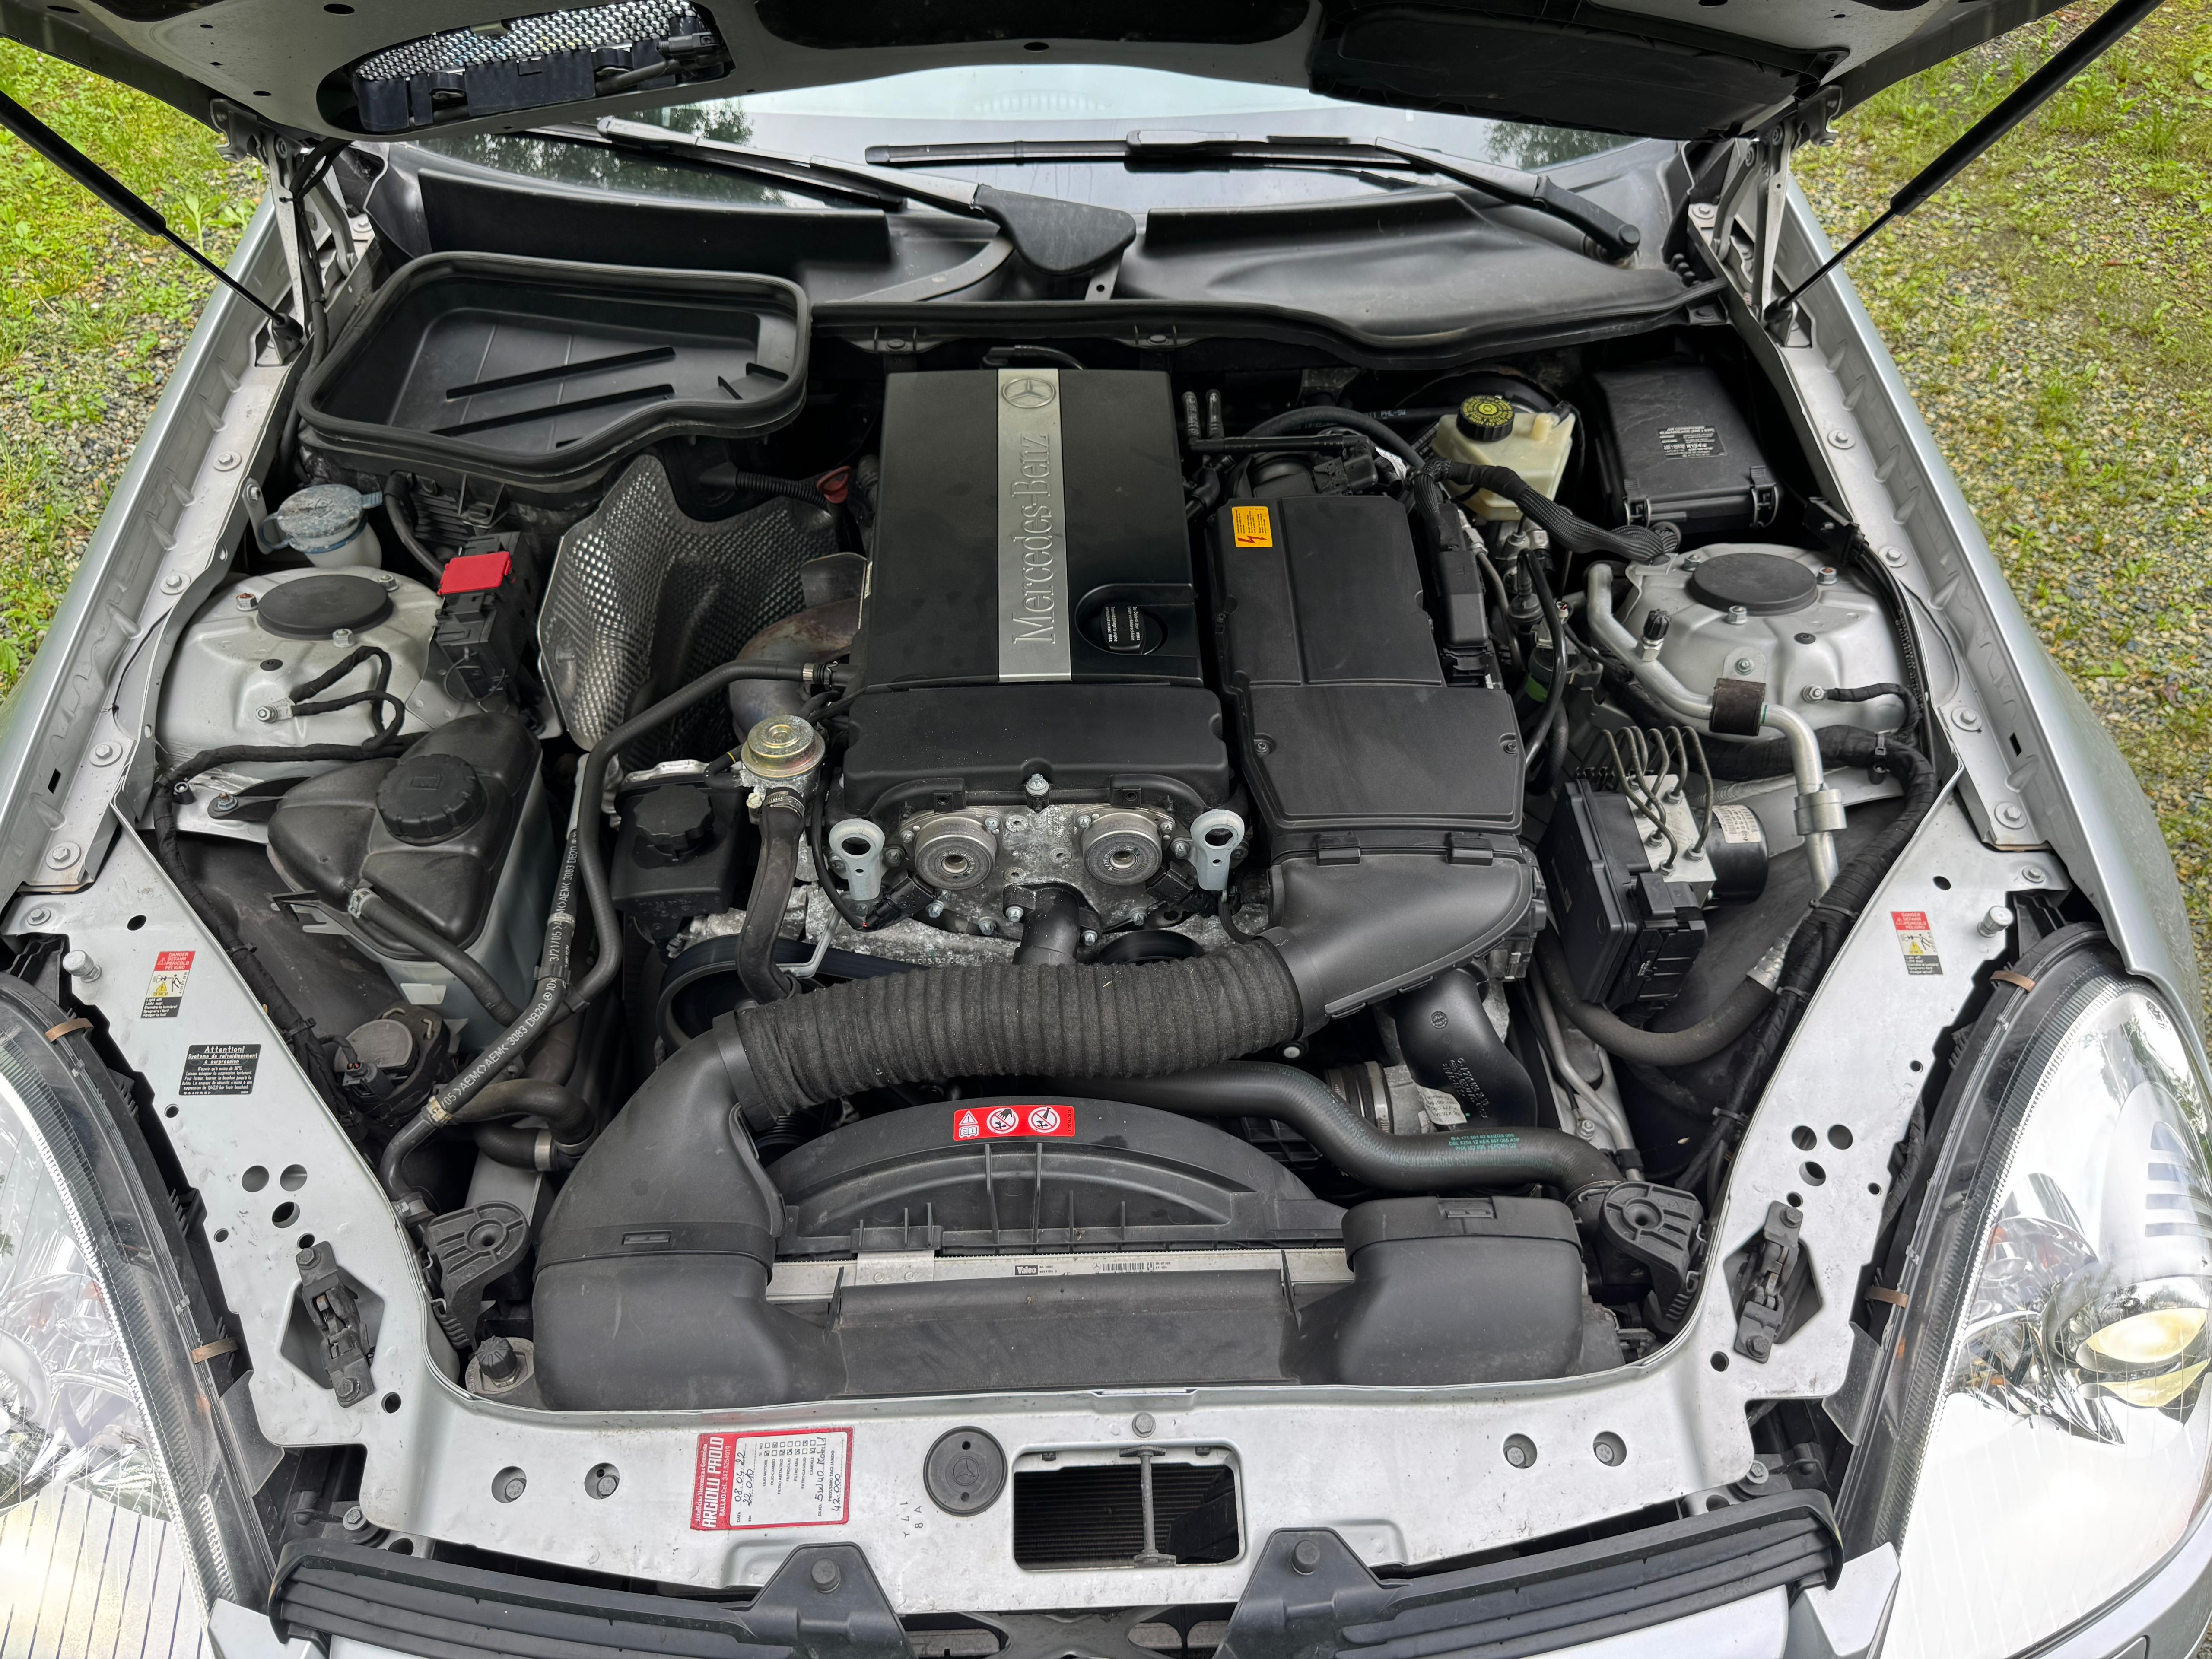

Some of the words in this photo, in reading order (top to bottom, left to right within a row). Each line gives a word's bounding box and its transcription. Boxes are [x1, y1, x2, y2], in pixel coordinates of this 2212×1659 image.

[1011, 433, 1055, 644] Mercedes-Benz
[563, 862, 575, 881] 3083
[506, 1025, 528, 1046] 3083
[524, 1002, 548, 1028] DB20
[1017, 1266, 1036, 1274] Valeo
[707, 1437, 724, 1474] PAOLO
[722, 1445, 731, 1481] 347.5254019
[702, 1478, 720, 1528] ARGIOLU
